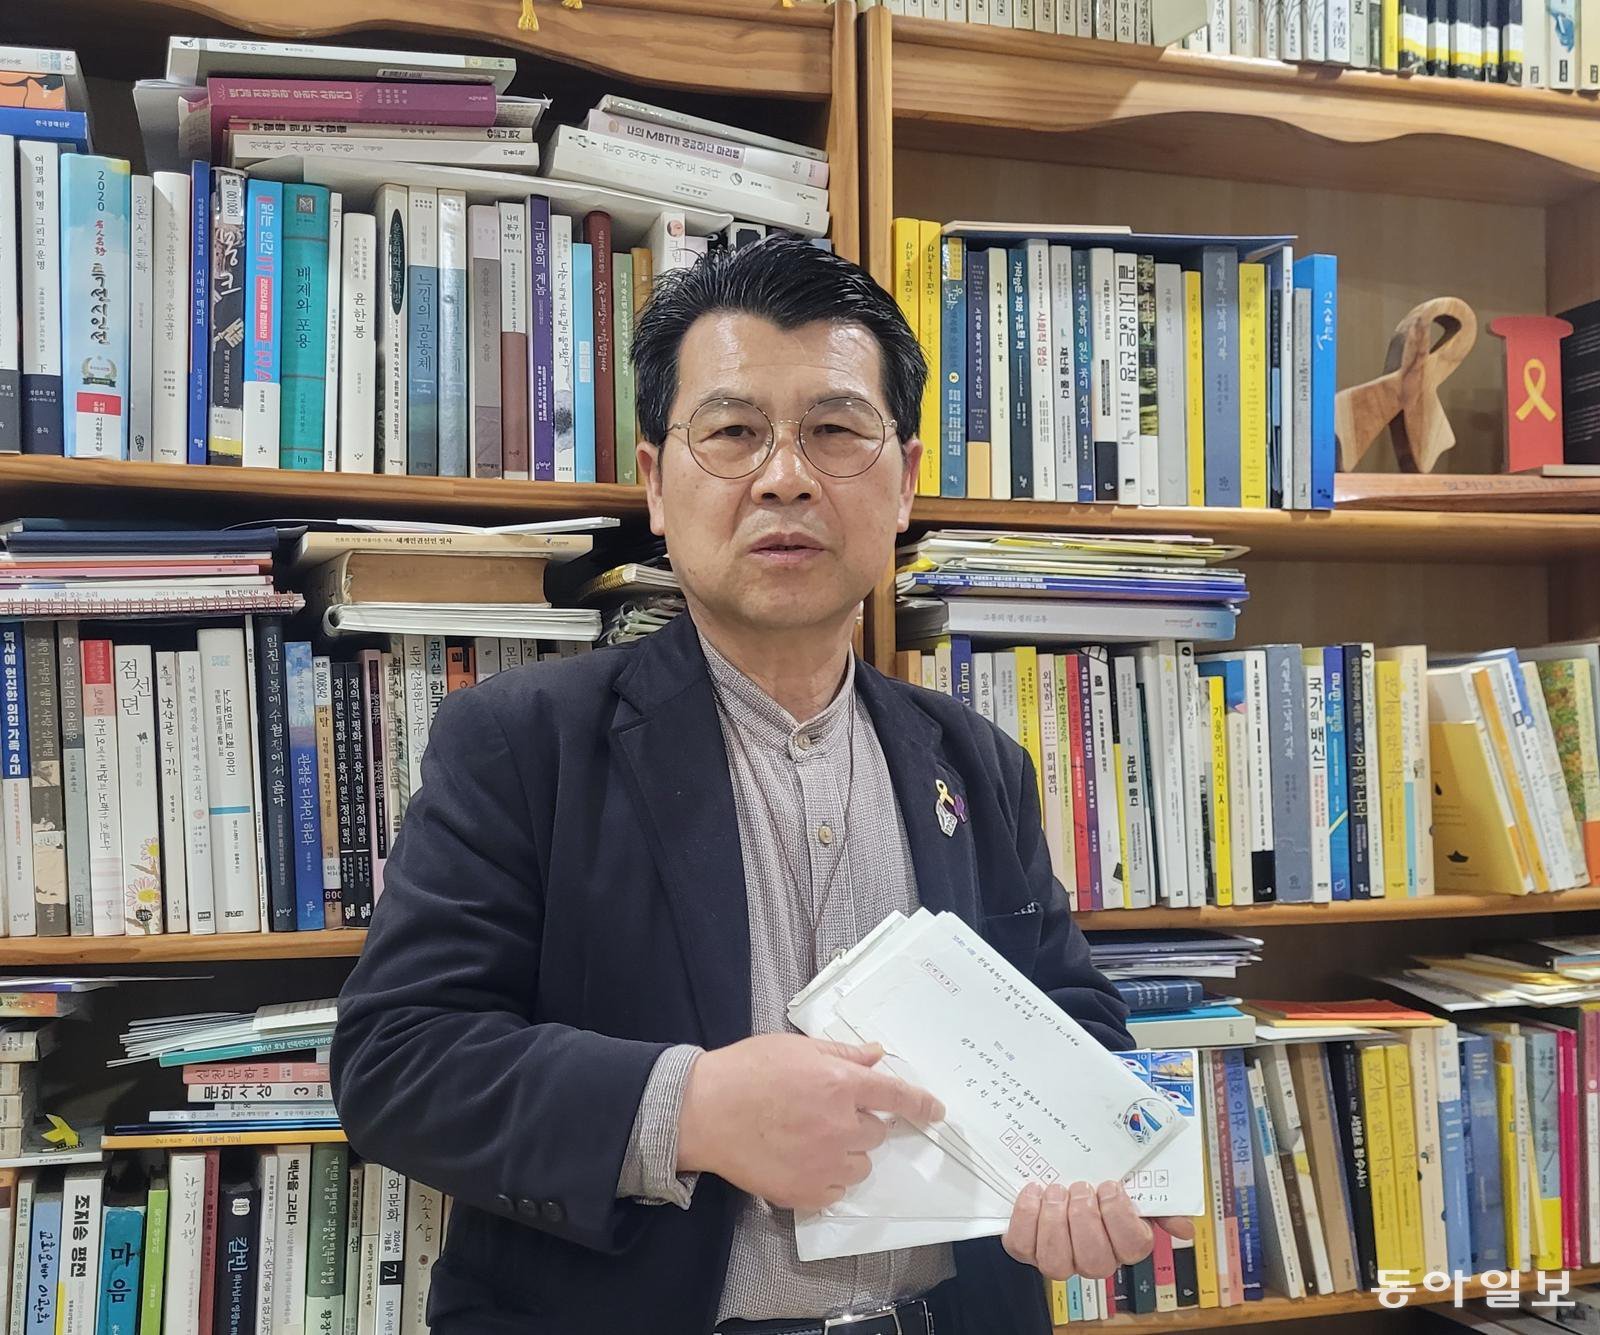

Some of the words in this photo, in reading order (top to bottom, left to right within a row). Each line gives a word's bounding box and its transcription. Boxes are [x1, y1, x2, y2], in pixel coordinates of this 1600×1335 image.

[626, 125, 645, 138] 나의
[646, 127, 681, 146] MBTI가
[35, 155, 45, 186] 여명과
[97, 170, 105, 212] 2020
[261, 203, 274, 227] 읽는
[506, 215, 519, 223] 나의
[503, 233, 522, 241] 여행기
[507, 224, 519, 232] 문구
[261, 231, 274, 256] 인간
[535, 221, 546, 268] 그리움의
[196, 269, 205, 297] 시네마
[1012, 261, 1024, 294] 가라앉은
[1118, 264, 1135, 312] 끝나지
[296, 266, 311, 314] 배제와
[416, 275, 432, 319] 느낌의
[196, 299, 205, 327] 테라피
[1014, 296, 1024, 312] 자와
[353, 293, 367, 340] 윤한봉
[557, 319, 569, 335] 깊이
[1015, 314, 1026, 339] 구조된
[1036, 311, 1047, 343] 사회적
[296, 318, 311, 349] 포용
[1119, 316, 1136, 347] 않은
[416, 323, 432, 373] 공동체
[557, 335, 569, 369] 들어왔다
[1015, 340, 1025, 350] 자
[1038, 346, 1048, 367] 영성
[1078, 341, 1088, 364] 있는
[1216, 336, 1228, 361] 기록
[1060, 346, 1070, 376] 재난을
[1120, 350, 1137, 382] 전쟁
[1060, 380, 1070, 400] 묻다
[1079, 368, 1089, 389] 곳이
[395, 536, 437, 545] 세계인권선언
[983, 613, 1006, 622] 고통의
[1032, 615, 1048, 624] 고통
[3, 631, 16, 664] 역사에
[37, 638, 48, 656] 제인
[266, 635, 281, 675] 임진년
[410, 646, 422, 669] 내가
[526, 647, 533, 657] 2
[39, 658, 50, 687] 구달의
[63, 656, 74, 677] 어른
[5, 667, 18, 701] 헌신한
[65, 680, 75, 710] 되기의
[333, 677, 344, 701] 정의
[349, 677, 360, 701] 정의
[40, 689, 52, 706] 생명
[222, 688, 233, 730] 노스포인트
[1309, 677, 1324, 721] 국가의
[7, 703, 19, 726] 의인
[41, 708, 53, 726] 사랑
[189, 706, 198, 733] 생각을
[335, 702, 345, 719] 없는
[350, 702, 361, 719] 없는
[7, 728, 20, 750] 가족
[66, 712, 78, 742] 어려움
[335, 720, 347, 742] 평화
[351, 720, 363, 742] 평화
[413, 717, 425, 737] 사는
[42, 731, 54, 758] 십계명
[95, 718, 106, 762] 라디오에서
[166, 741, 176, 753] 두
[191, 736, 200, 762] 너에게
[223, 730, 235, 749] 교회
[268, 709, 284, 776] 수월정에서
[337, 743, 347, 760] 없고
[352, 743, 363, 760] 없고
[1284, 738, 1295, 760] 기록
[1310, 728, 1326, 762] 배신
[9, 754, 21, 775] 4대
[165, 758, 178, 776] 기자
[192, 765, 201, 782] 주고
[225, 751, 236, 776] 이야기
[297, 753, 313, 786] 관점을
[337, 761, 349, 784] 용서
[353, 761, 364, 784] 용서
[194, 784, 202, 802] 싶다
[339, 785, 349, 802] 없는
[354, 785, 365, 802] 없는
[98, 792, 109, 821] 노래가
[339, 804, 350, 826] 정의
[356, 804, 366, 826] 정의
[99, 822, 111, 851] 흐른다
[341, 827, 351, 845] 없다
[357, 827, 367, 845] 없다
[195, 1066, 258, 1081] 실천문학
[204, 1084, 272, 1100] 문학사상
[293, 1086, 310, 1098] 3
[1231, 1101, 1247, 1130] 이후
[287, 1159, 300, 1192] 백년을
[324, 1156, 338, 1181] 개인의
[72, 1194, 91, 1241] 조지송
[285, 1192, 299, 1226] 그리다
[391, 1229, 401, 1254] 2024년
[70, 1246, 88, 1278] 평전
[227, 1237, 250, 1273] 칼빈
[320, 1266, 335, 1286] 생명
[383, 1263, 398, 1282] 71
